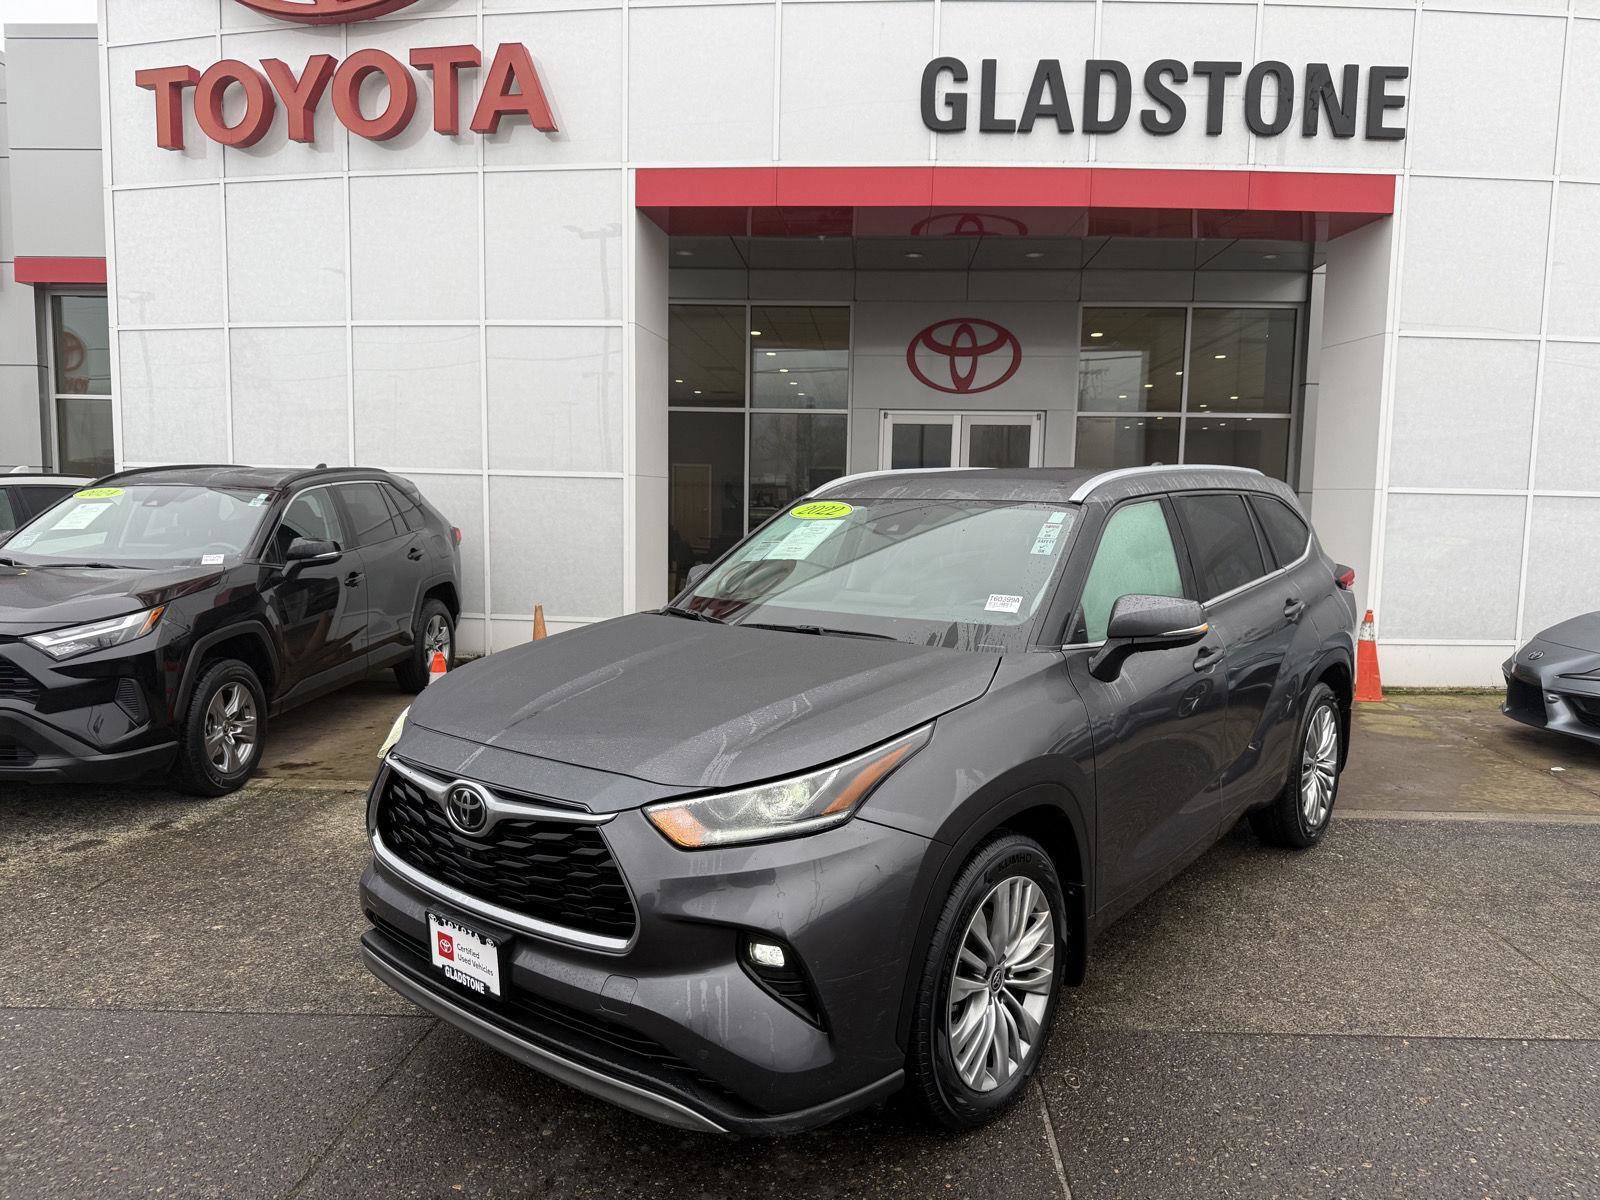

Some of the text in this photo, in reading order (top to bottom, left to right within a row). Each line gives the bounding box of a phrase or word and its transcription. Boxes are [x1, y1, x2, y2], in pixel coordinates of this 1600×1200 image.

[135, 42, 559, 151] TOYOTA
[920, 56, 1409, 140] GLADSTONE
[796, 505, 846, 516] 2022
[441, 918, 481, 940] TOYOTA
[456, 943, 480, 959] Certified
[457, 953, 494, 977] Used Vehicles
[444, 965, 486, 995] GLADSTONE
